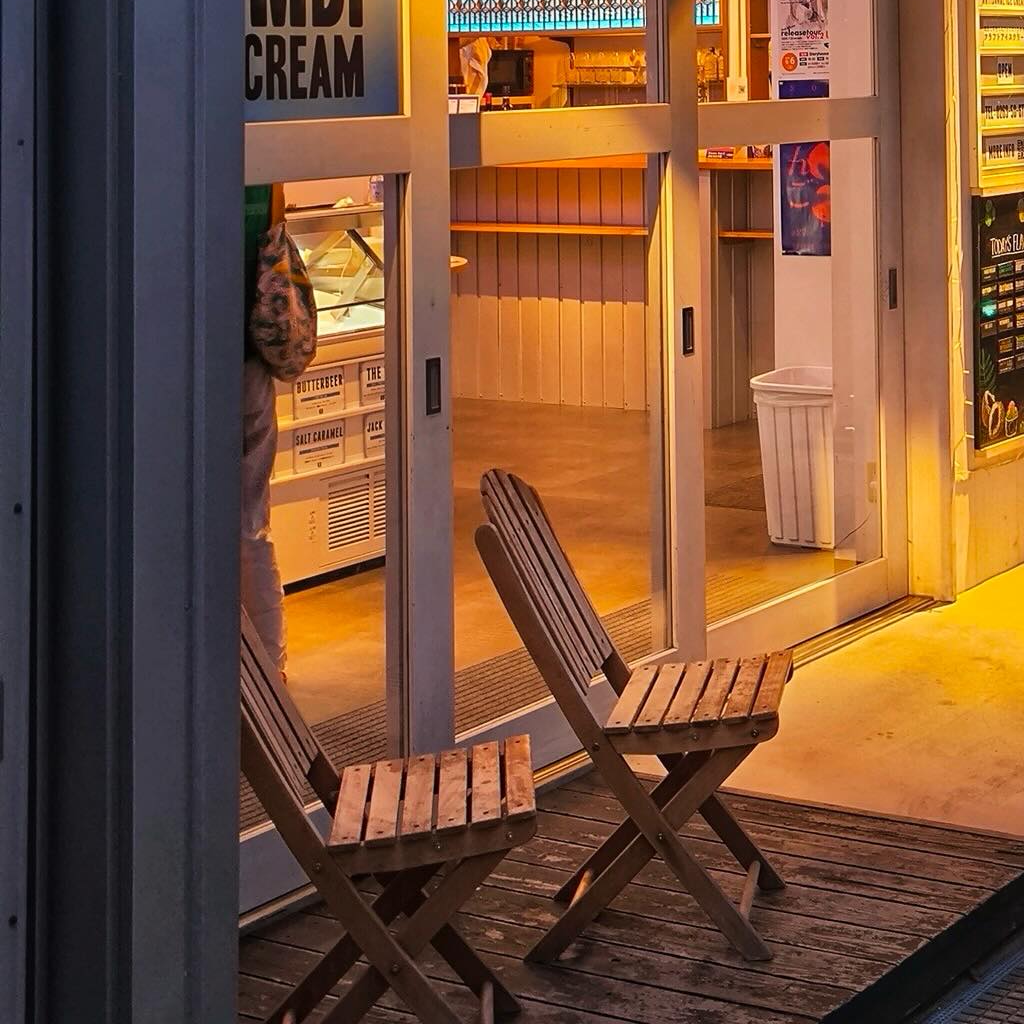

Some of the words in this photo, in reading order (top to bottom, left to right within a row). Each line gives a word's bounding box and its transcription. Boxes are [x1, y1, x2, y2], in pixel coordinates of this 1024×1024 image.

[244, 33, 365, 102] CREAM
[998, 62, 1012, 79] OPEN
[988, 144, 1003, 160] MORE
[1003, 143, 1015, 159] INFO
[366, 366, 382, 381] THE
[296, 374, 343, 394] BUTTERBEER
[366, 420, 383, 433] JACK
[295, 432, 311, 446] SALT
[312, 426, 343, 442] CARAMEL
